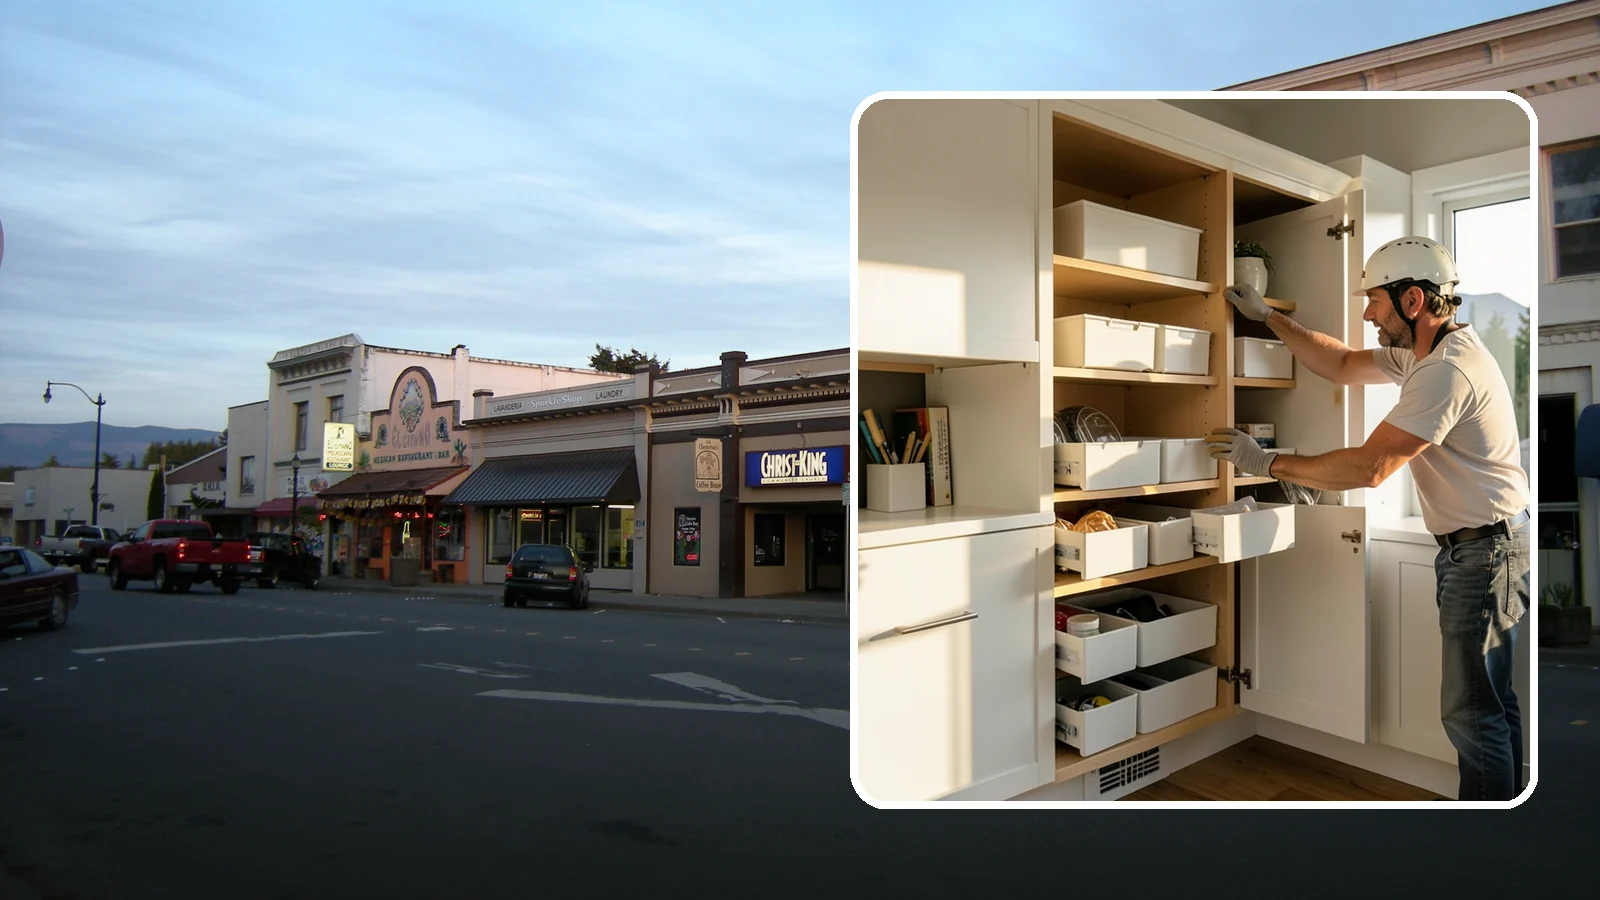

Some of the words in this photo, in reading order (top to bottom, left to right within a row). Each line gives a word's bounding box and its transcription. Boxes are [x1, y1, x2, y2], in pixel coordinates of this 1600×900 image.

[493, 402, 523, 413] LAVANDERIA
[560, 394, 582, 405] Shop
[595, 388, 624, 400] LAUNDRY
[374, 456, 396, 464] MEXICAN
[398, 452, 434, 462] RESTAURANT
[438, 451, 450, 459] BAR
[761, 453, 797, 479] CHRIST
[799, 450, 828, 477] KING
